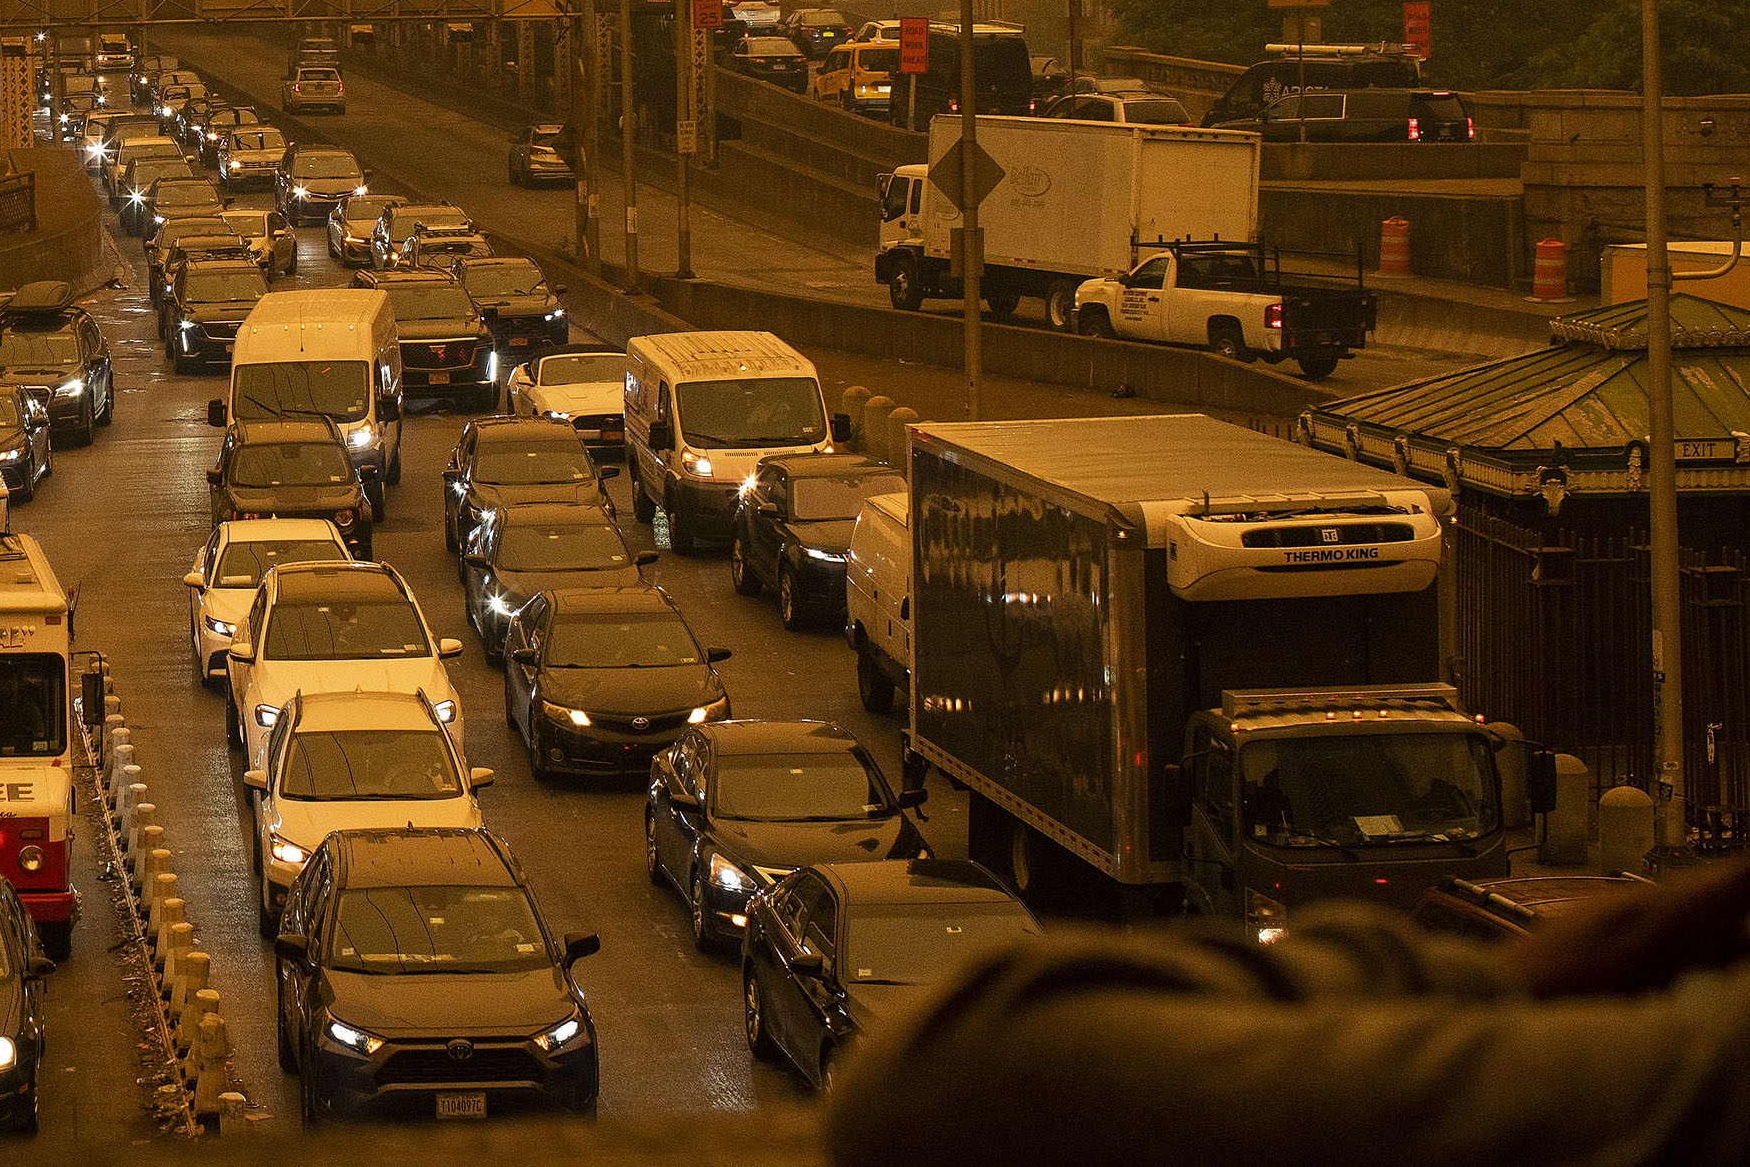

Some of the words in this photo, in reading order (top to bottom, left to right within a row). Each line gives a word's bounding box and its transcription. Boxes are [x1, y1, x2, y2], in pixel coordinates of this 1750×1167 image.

[700, 12, 718, 24] 25
[1682, 442, 1716, 456] EXIT
[1284, 550, 1344, 562] THERMO
[1346, 548, 1378, 560] KING
